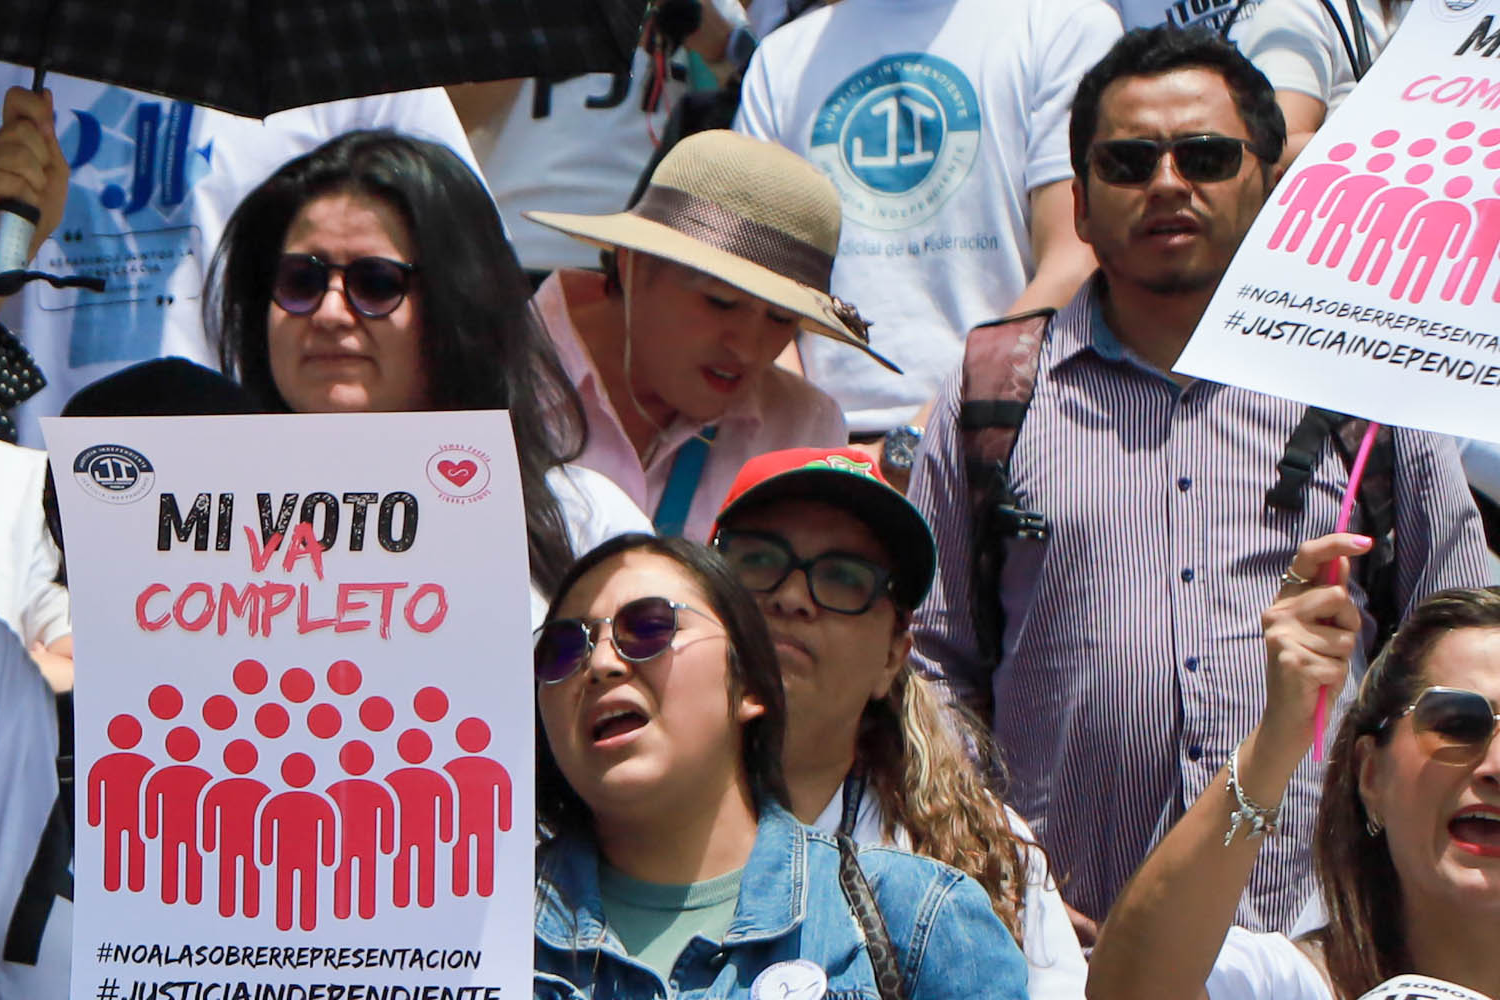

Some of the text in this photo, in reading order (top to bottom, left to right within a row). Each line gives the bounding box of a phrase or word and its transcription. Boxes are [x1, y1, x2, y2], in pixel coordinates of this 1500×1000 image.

[1401, 75, 1500, 111] COM
[1224, 310, 1500, 386] #JUSTICIAINDEPENDIE
[1237, 283, 1500, 356] #NOALASOBRERREPRESENTA
[157, 492, 420, 553] MI VOTO
[243, 521, 325, 581] VA
[135, 580, 449, 640] COMPLETO
[96, 942, 483, 971] #NOALASOBRERREPRESENTACION
